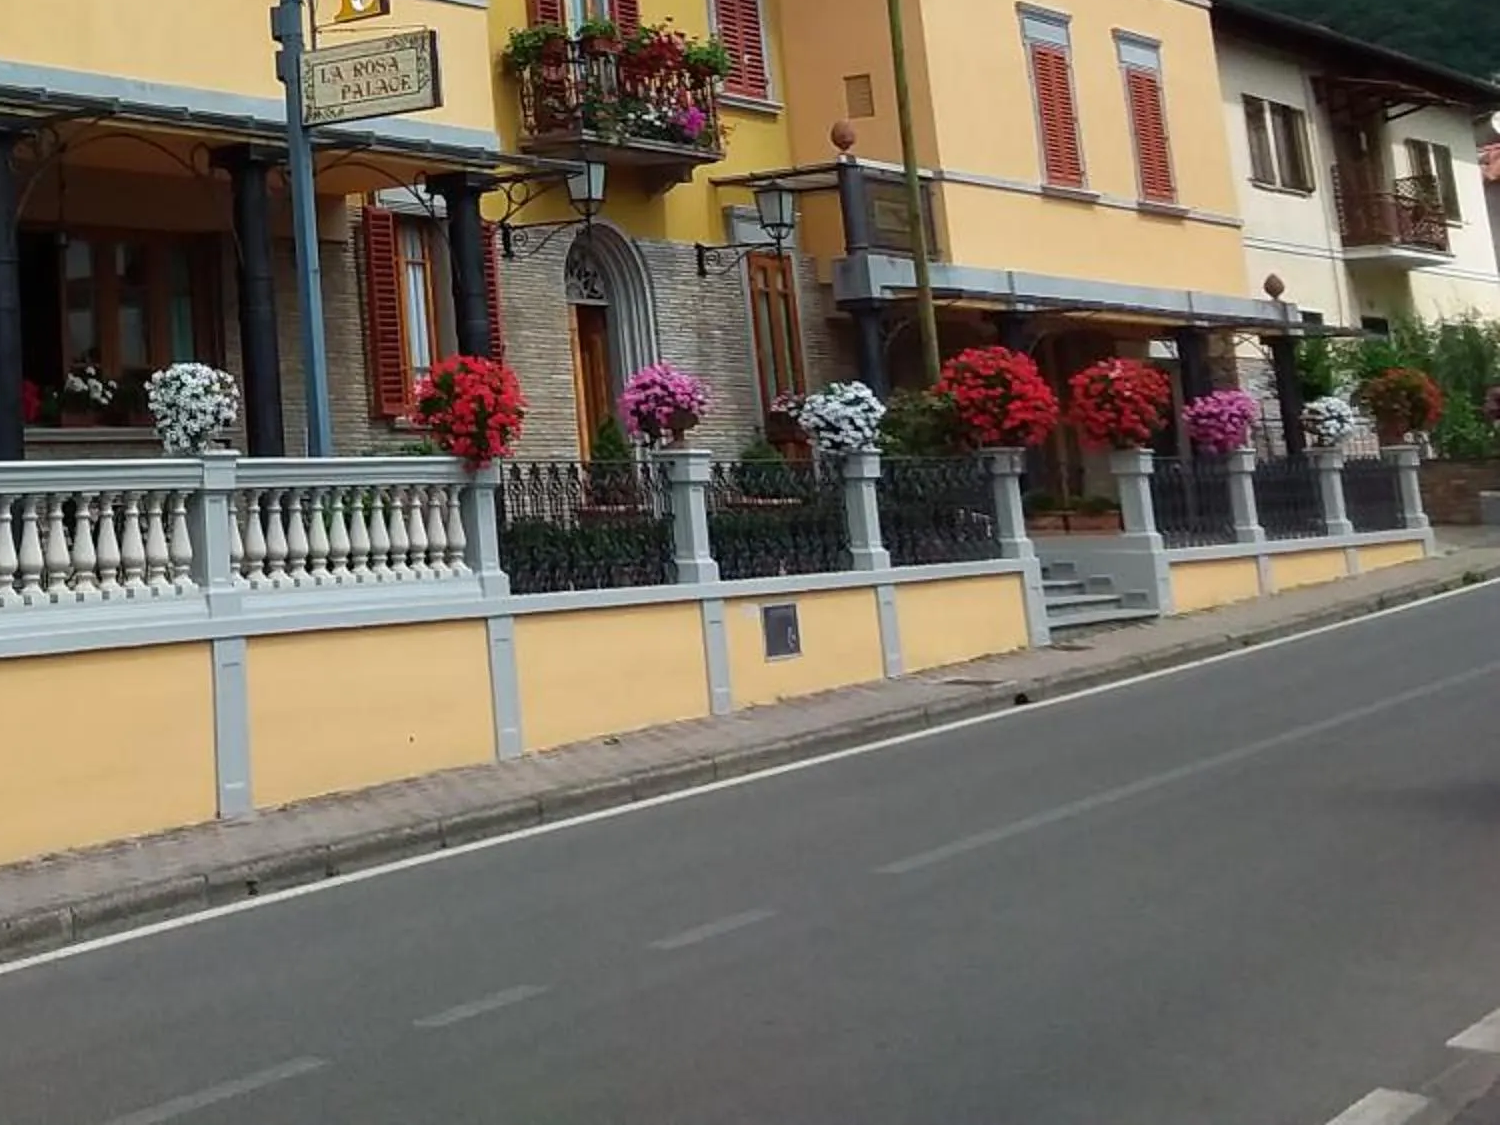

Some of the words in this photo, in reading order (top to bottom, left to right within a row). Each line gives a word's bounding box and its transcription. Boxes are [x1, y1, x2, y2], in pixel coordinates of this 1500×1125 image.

[321, 66, 344, 84] LA
[353, 56, 399, 78] ROSA
[341, 74, 412, 101] PALACE
